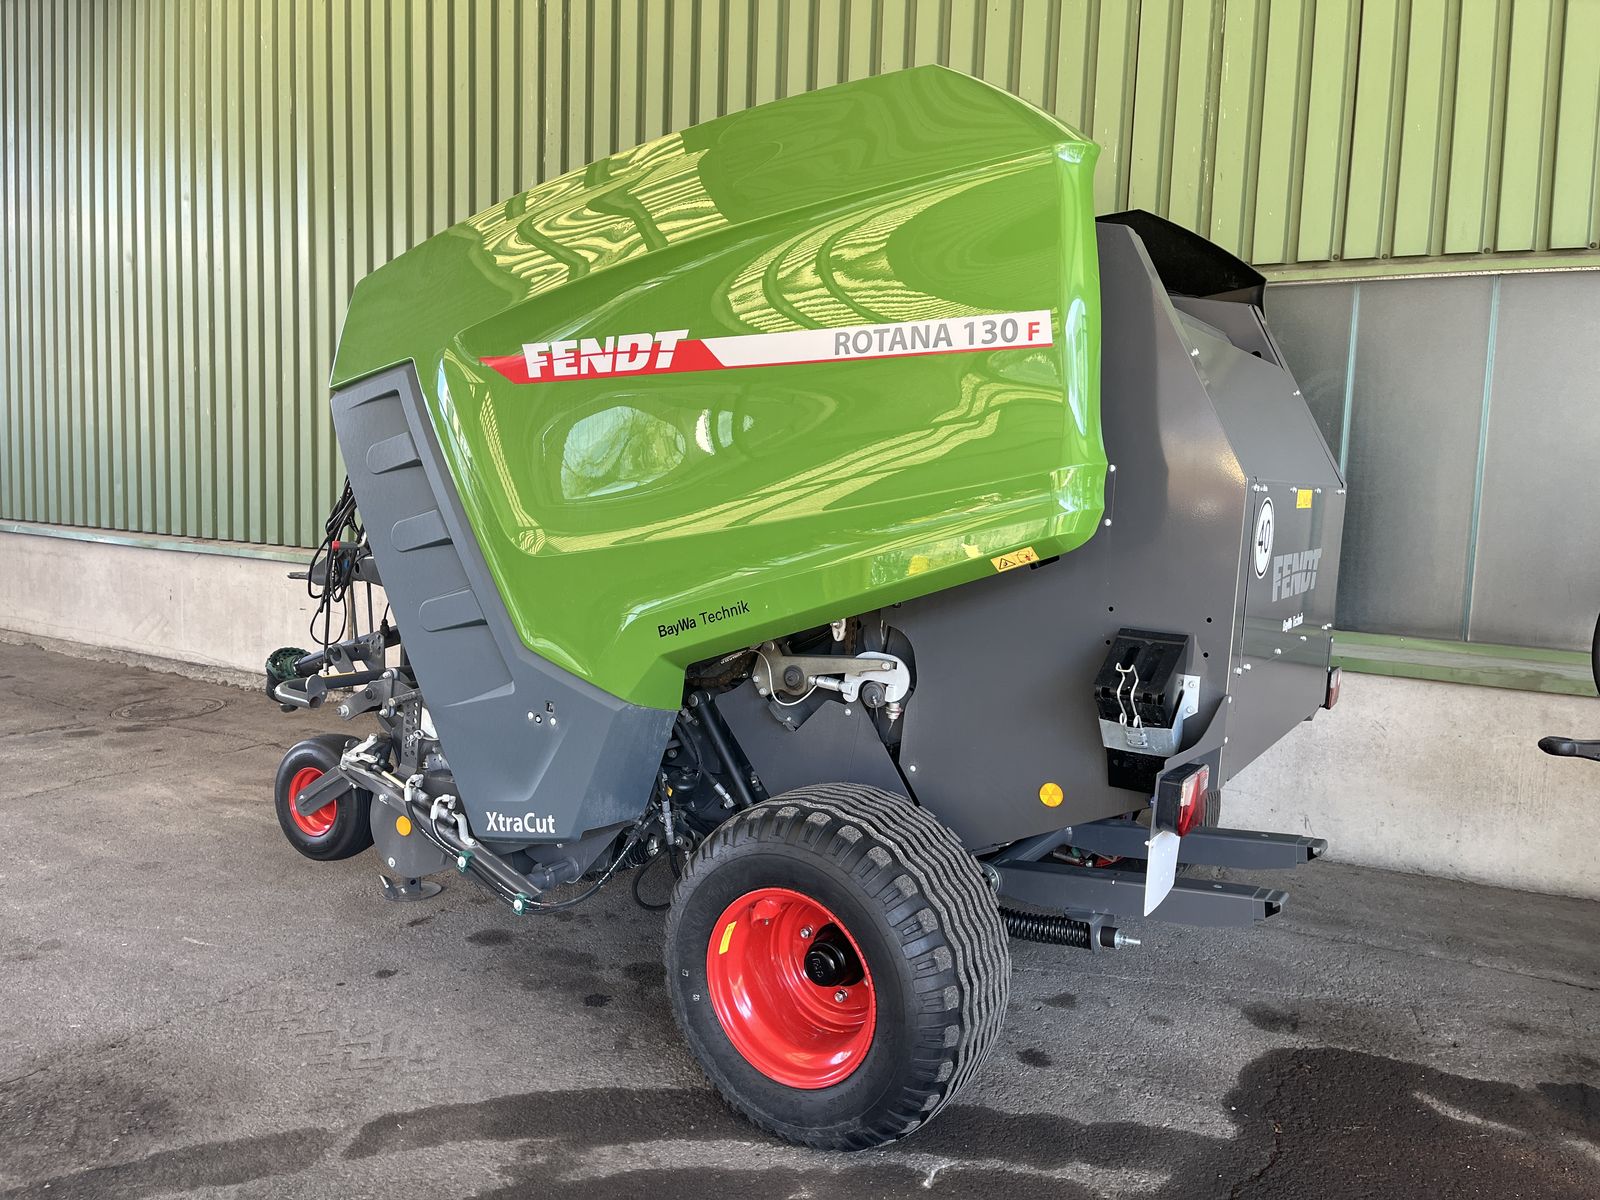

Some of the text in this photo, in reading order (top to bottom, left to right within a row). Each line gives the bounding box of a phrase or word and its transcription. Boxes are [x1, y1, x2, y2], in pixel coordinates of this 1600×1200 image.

[522, 329, 689, 378] FENDT
[834, 318, 1041, 356] ROTANA 130 F
[1257, 519, 1271, 554] 40
[1272, 547, 1322, 602] FENDT
[657, 600, 750, 638] BayWa Technik
[485, 811, 556, 834] XtraCut
